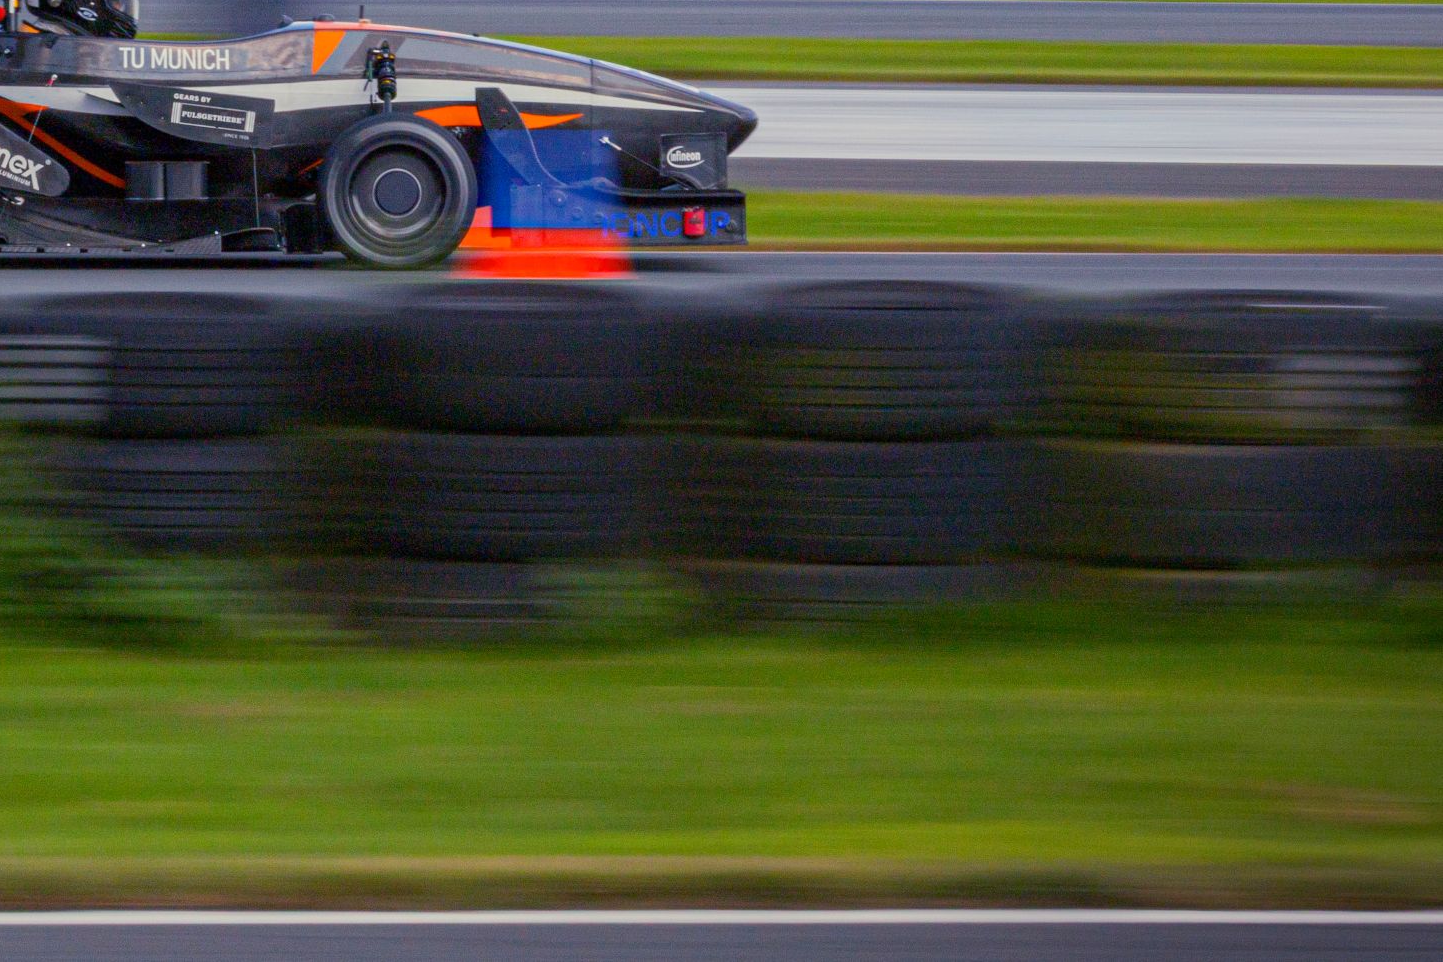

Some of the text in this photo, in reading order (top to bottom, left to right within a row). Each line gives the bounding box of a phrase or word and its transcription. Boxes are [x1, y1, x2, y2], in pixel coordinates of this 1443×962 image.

[119, 46, 230, 70] TU MUNICH
[173, 93, 199, 102] GEARS
